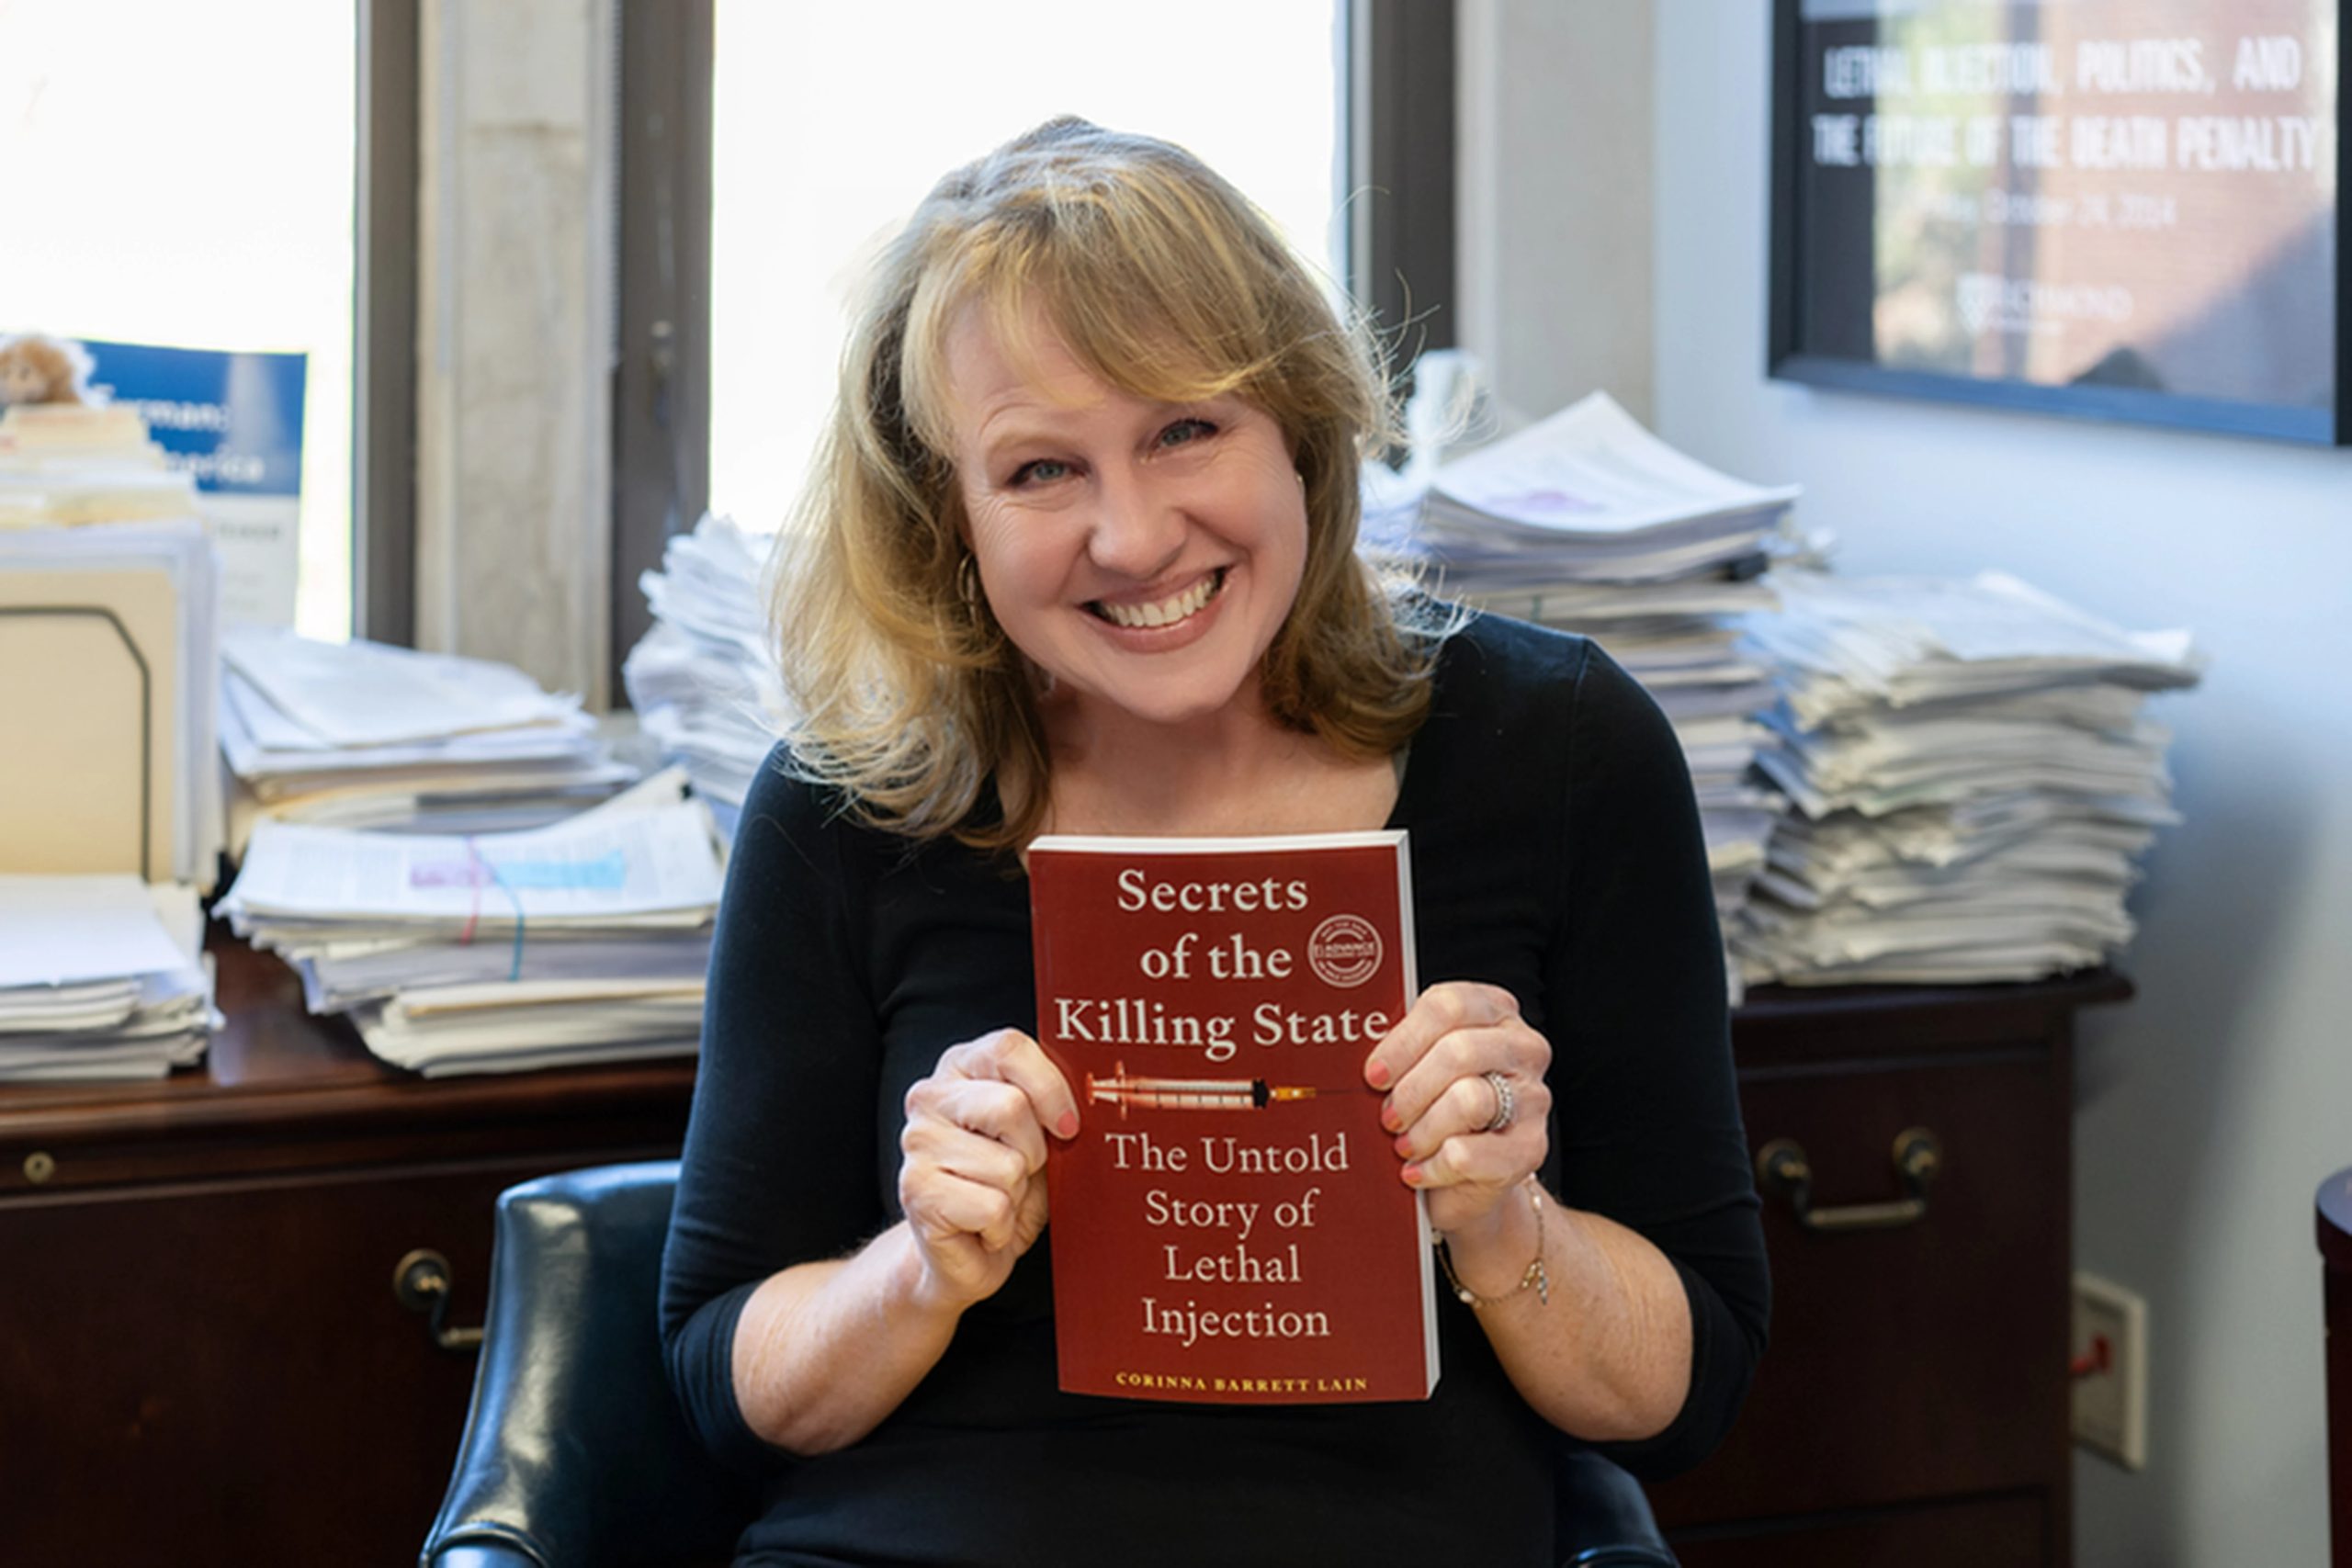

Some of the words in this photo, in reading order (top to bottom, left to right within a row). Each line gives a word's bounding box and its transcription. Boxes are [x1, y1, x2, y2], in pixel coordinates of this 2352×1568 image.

[2233, 35, 2302, 91] AND
[1811, 113, 1860, 167] THE
[1964, 114, 2001, 167] OF
[2010, 115, 2063, 169] THE
[2071, 115, 2166, 170] DEATH
[2176, 115, 2316, 172] PENALTY
[1117, 868, 1309, 912] Secrets
[1140, 932, 1199, 979] of
[1207, 932, 1292, 979] the
[1055, 998, 1237, 1062] Killing
[1252, 1003, 1390, 1046] State
[1104, 1132, 1188, 1172] The
[1201, 1132, 1350, 1173] Untold
[1145, 1190, 1259, 1240] Story
[1273, 1187, 1321, 1227] of
[1163, 1244, 1302, 1282] Lethal
[1141, 1297, 1331, 1348] Injection
[1115, 1372, 1206, 1391] CORINNA
[1215, 1377, 1310, 1393] BARRETT
[1317, 1377, 1367, 1392] LAIN
